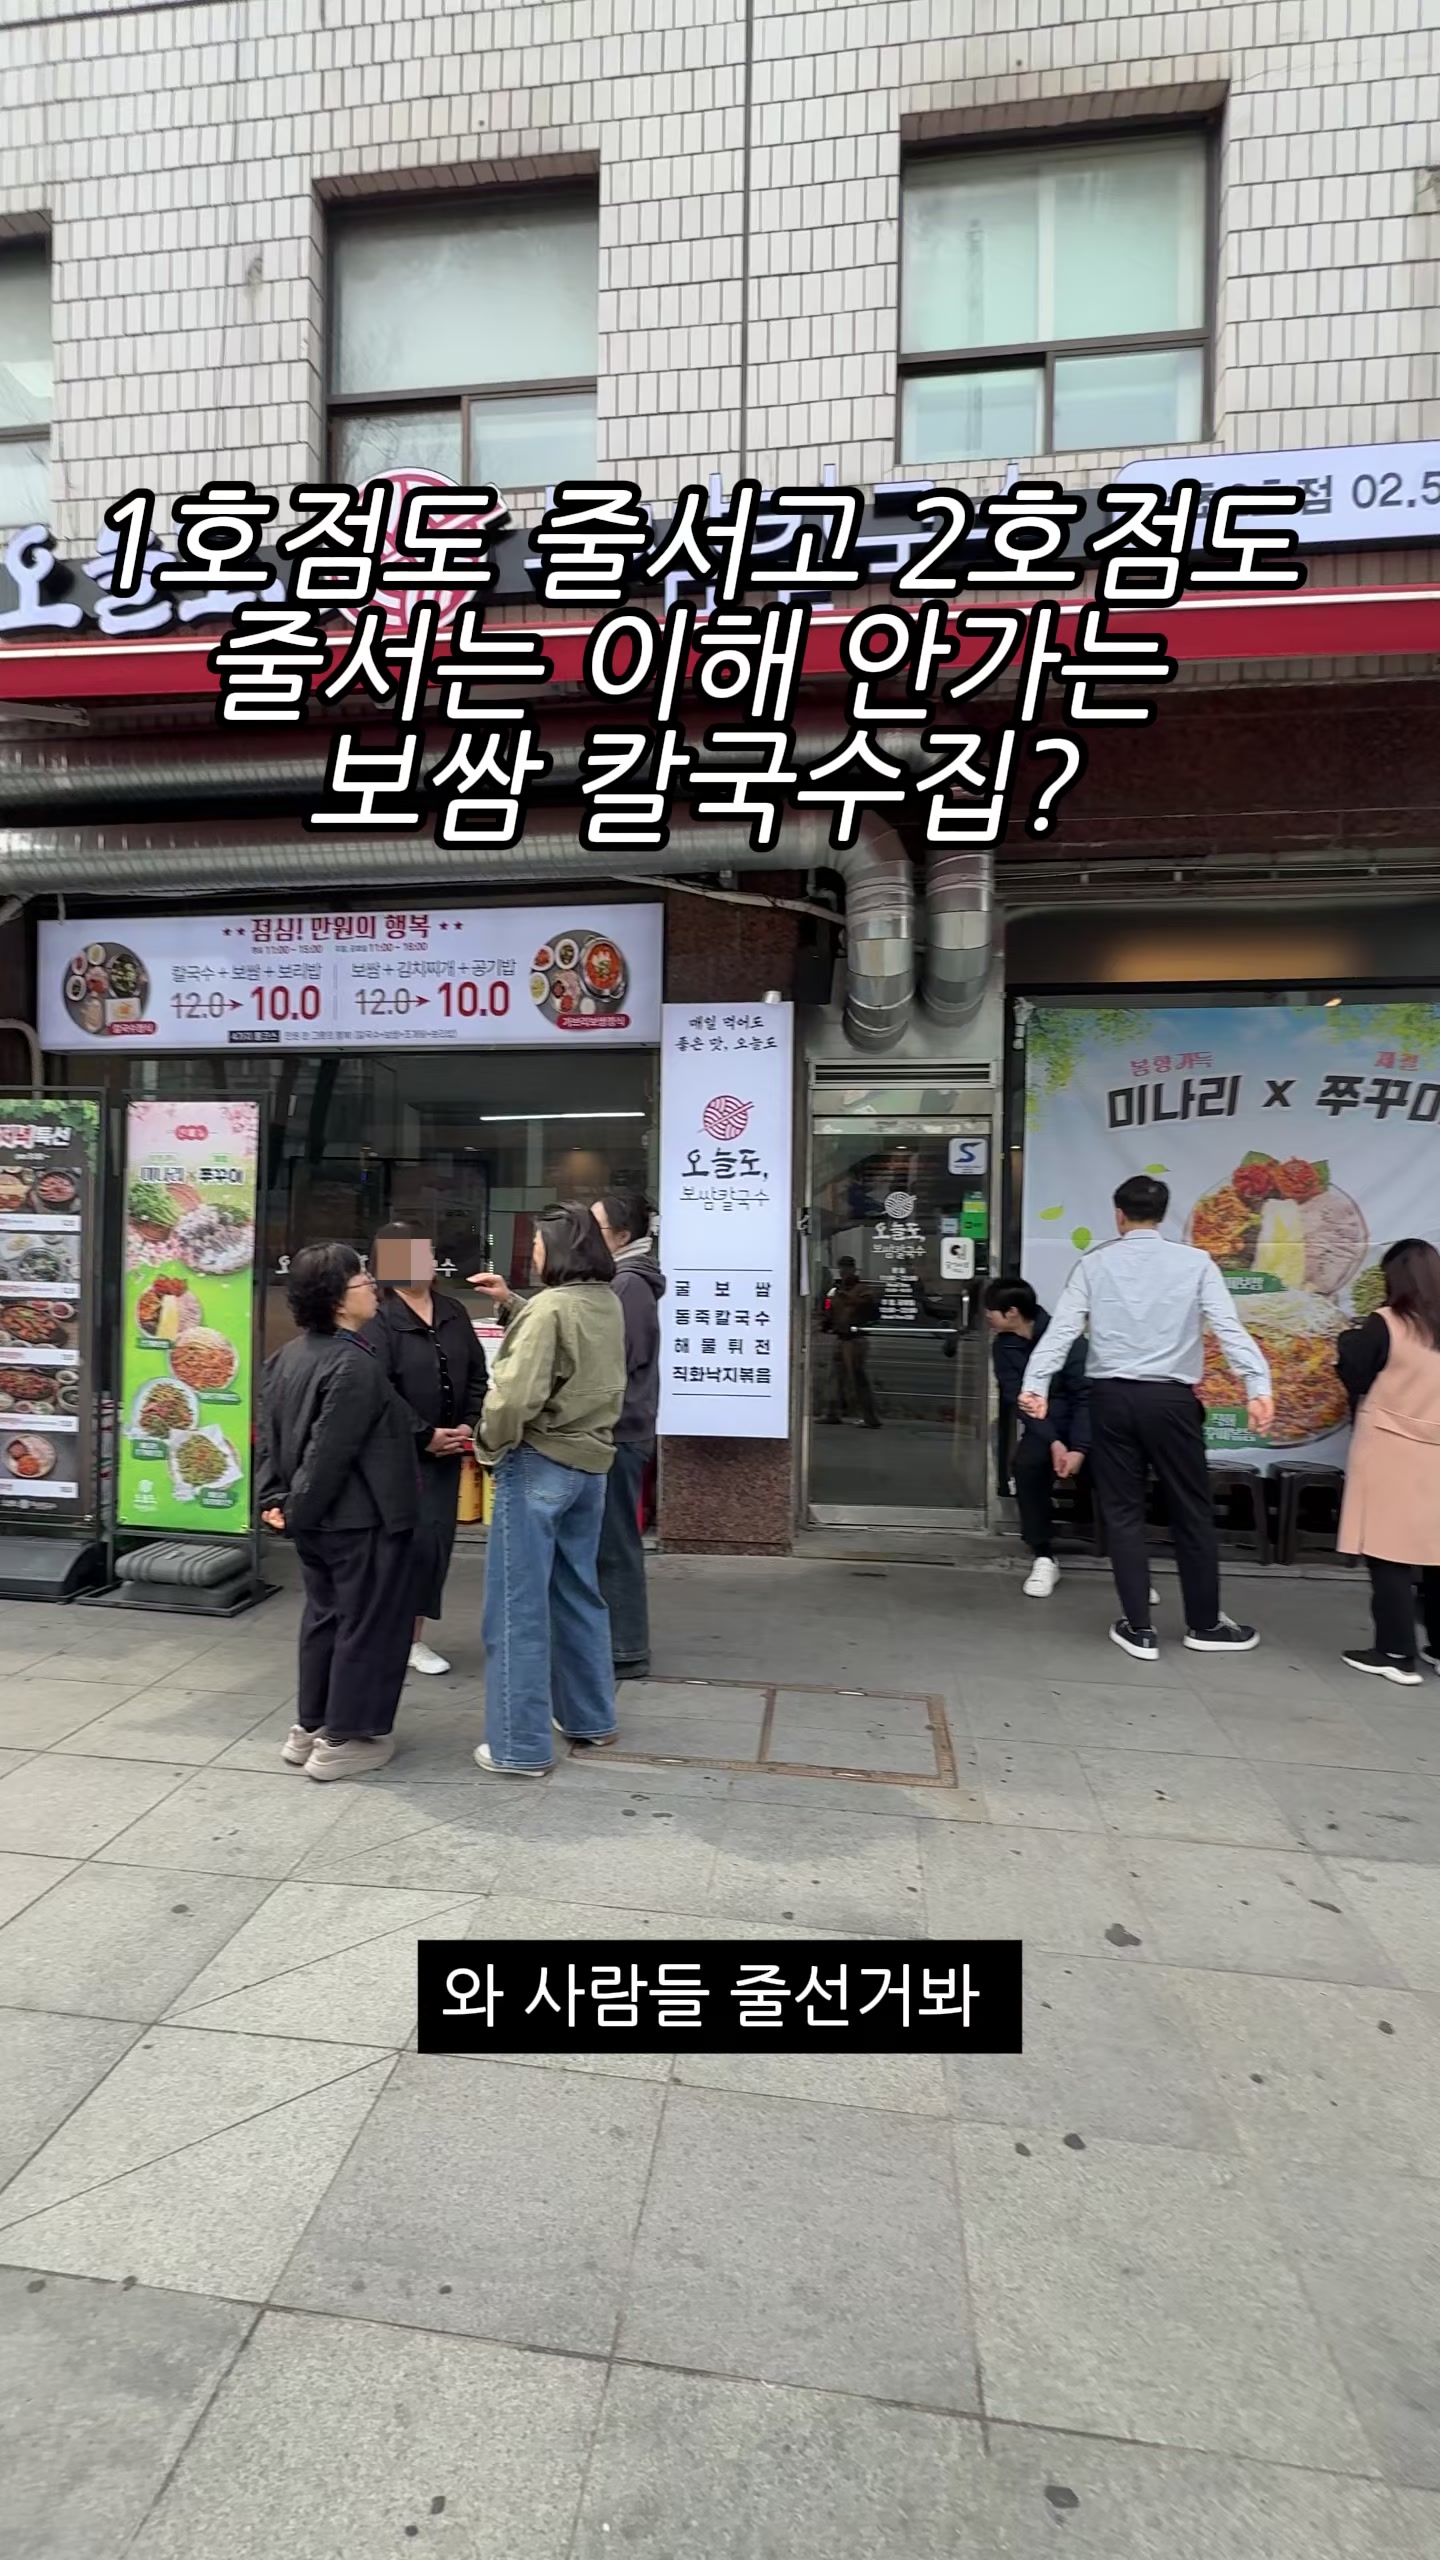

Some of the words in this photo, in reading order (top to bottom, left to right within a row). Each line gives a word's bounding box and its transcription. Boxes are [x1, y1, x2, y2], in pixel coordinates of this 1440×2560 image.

[252, 917, 303, 942] 점심!
[311, 915, 376, 941] 만원의
[384, 914, 431, 940] 행복
[251, 985, 321, 1021] 10.0
[437, 981, 510, 1017] 10.0
[688, 1015, 717, 1031] 매일
[722, 1015, 765, 1030] 먹어도
[675, 1036, 704, 1052] 좋은
[709, 1036, 729, 1052] 맛,
[733, 1036, 778, 1051] 오늘도
[1108, 1074, 1243, 1129] 미나리
[681, 1148, 768, 1182] 오늘도,
[679, 1186, 770, 1211] 보쌈칼국수
[673, 1366, 771, 1384] 직화낙지볶음
